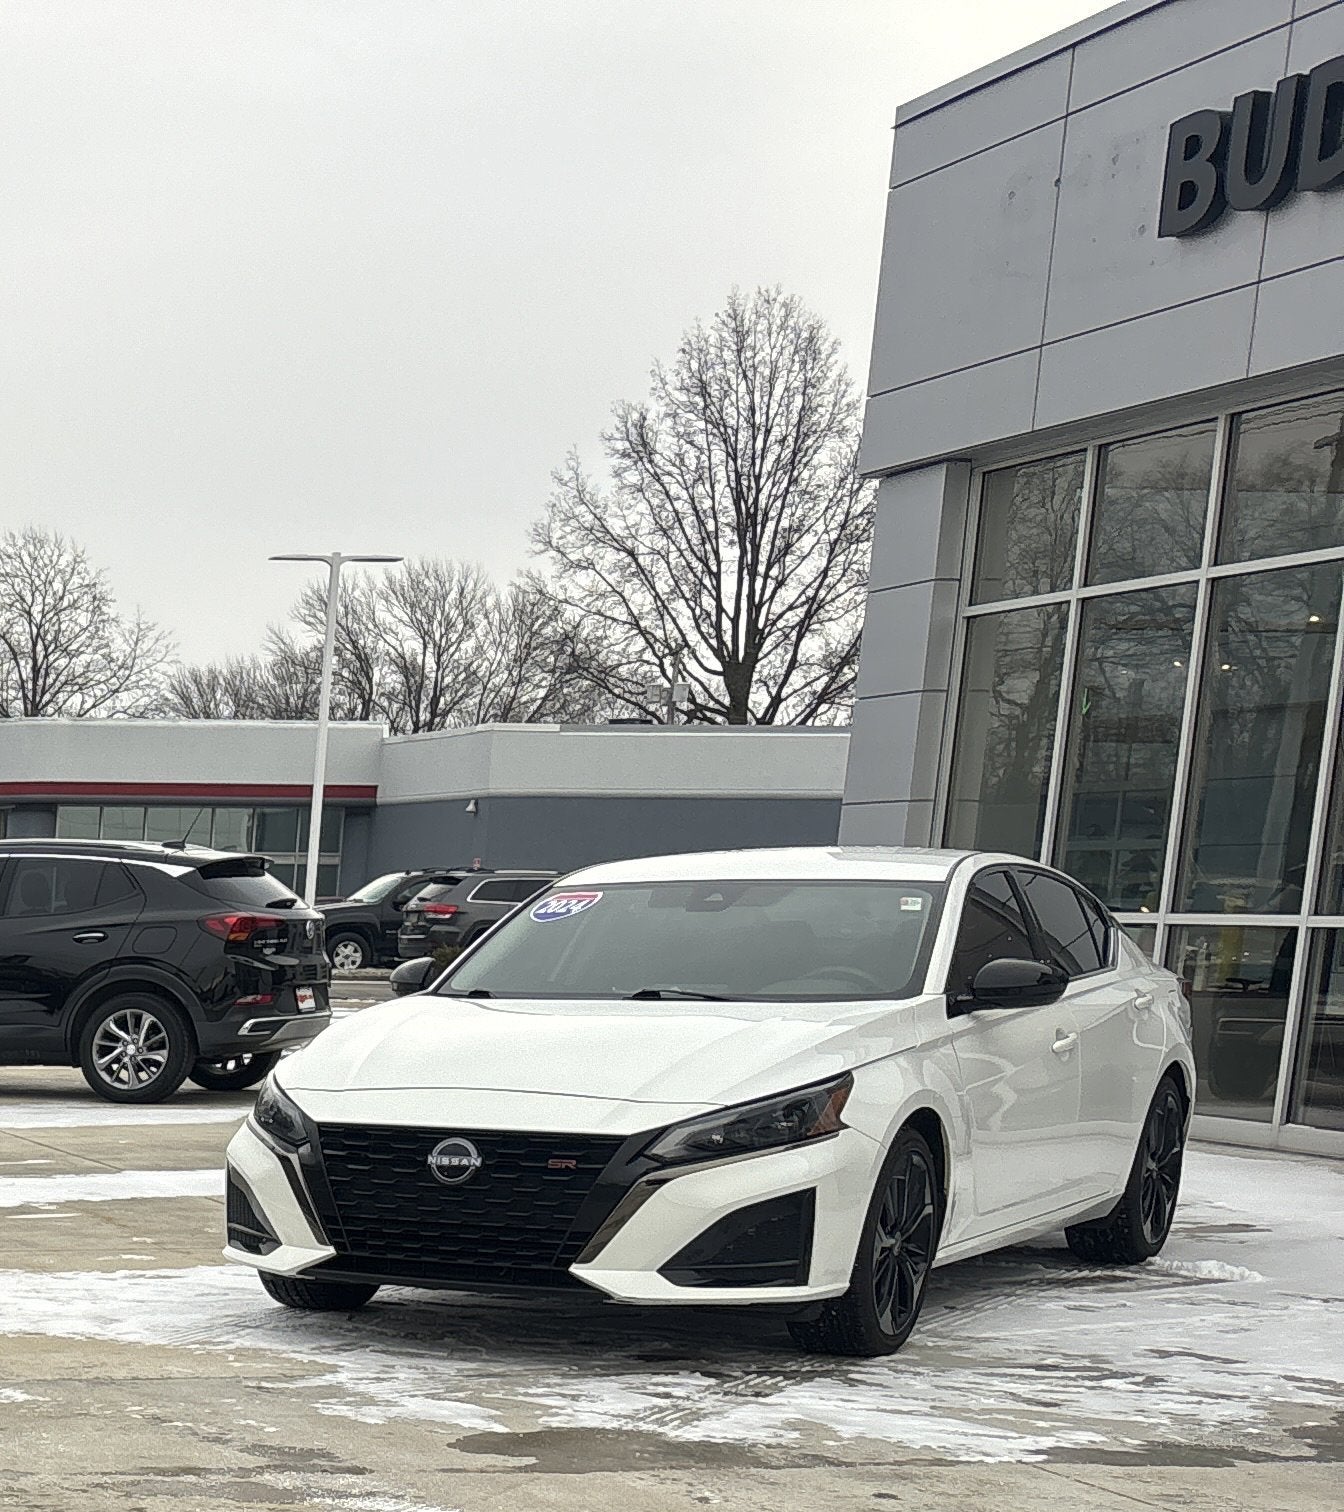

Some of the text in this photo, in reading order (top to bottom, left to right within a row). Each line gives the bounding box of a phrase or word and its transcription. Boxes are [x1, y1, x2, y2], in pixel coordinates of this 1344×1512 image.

[1158, 55, 1344, 238] BUD
[427, 1154, 482, 1168] NISSAN
[547, 1158, 577, 1170] SR
